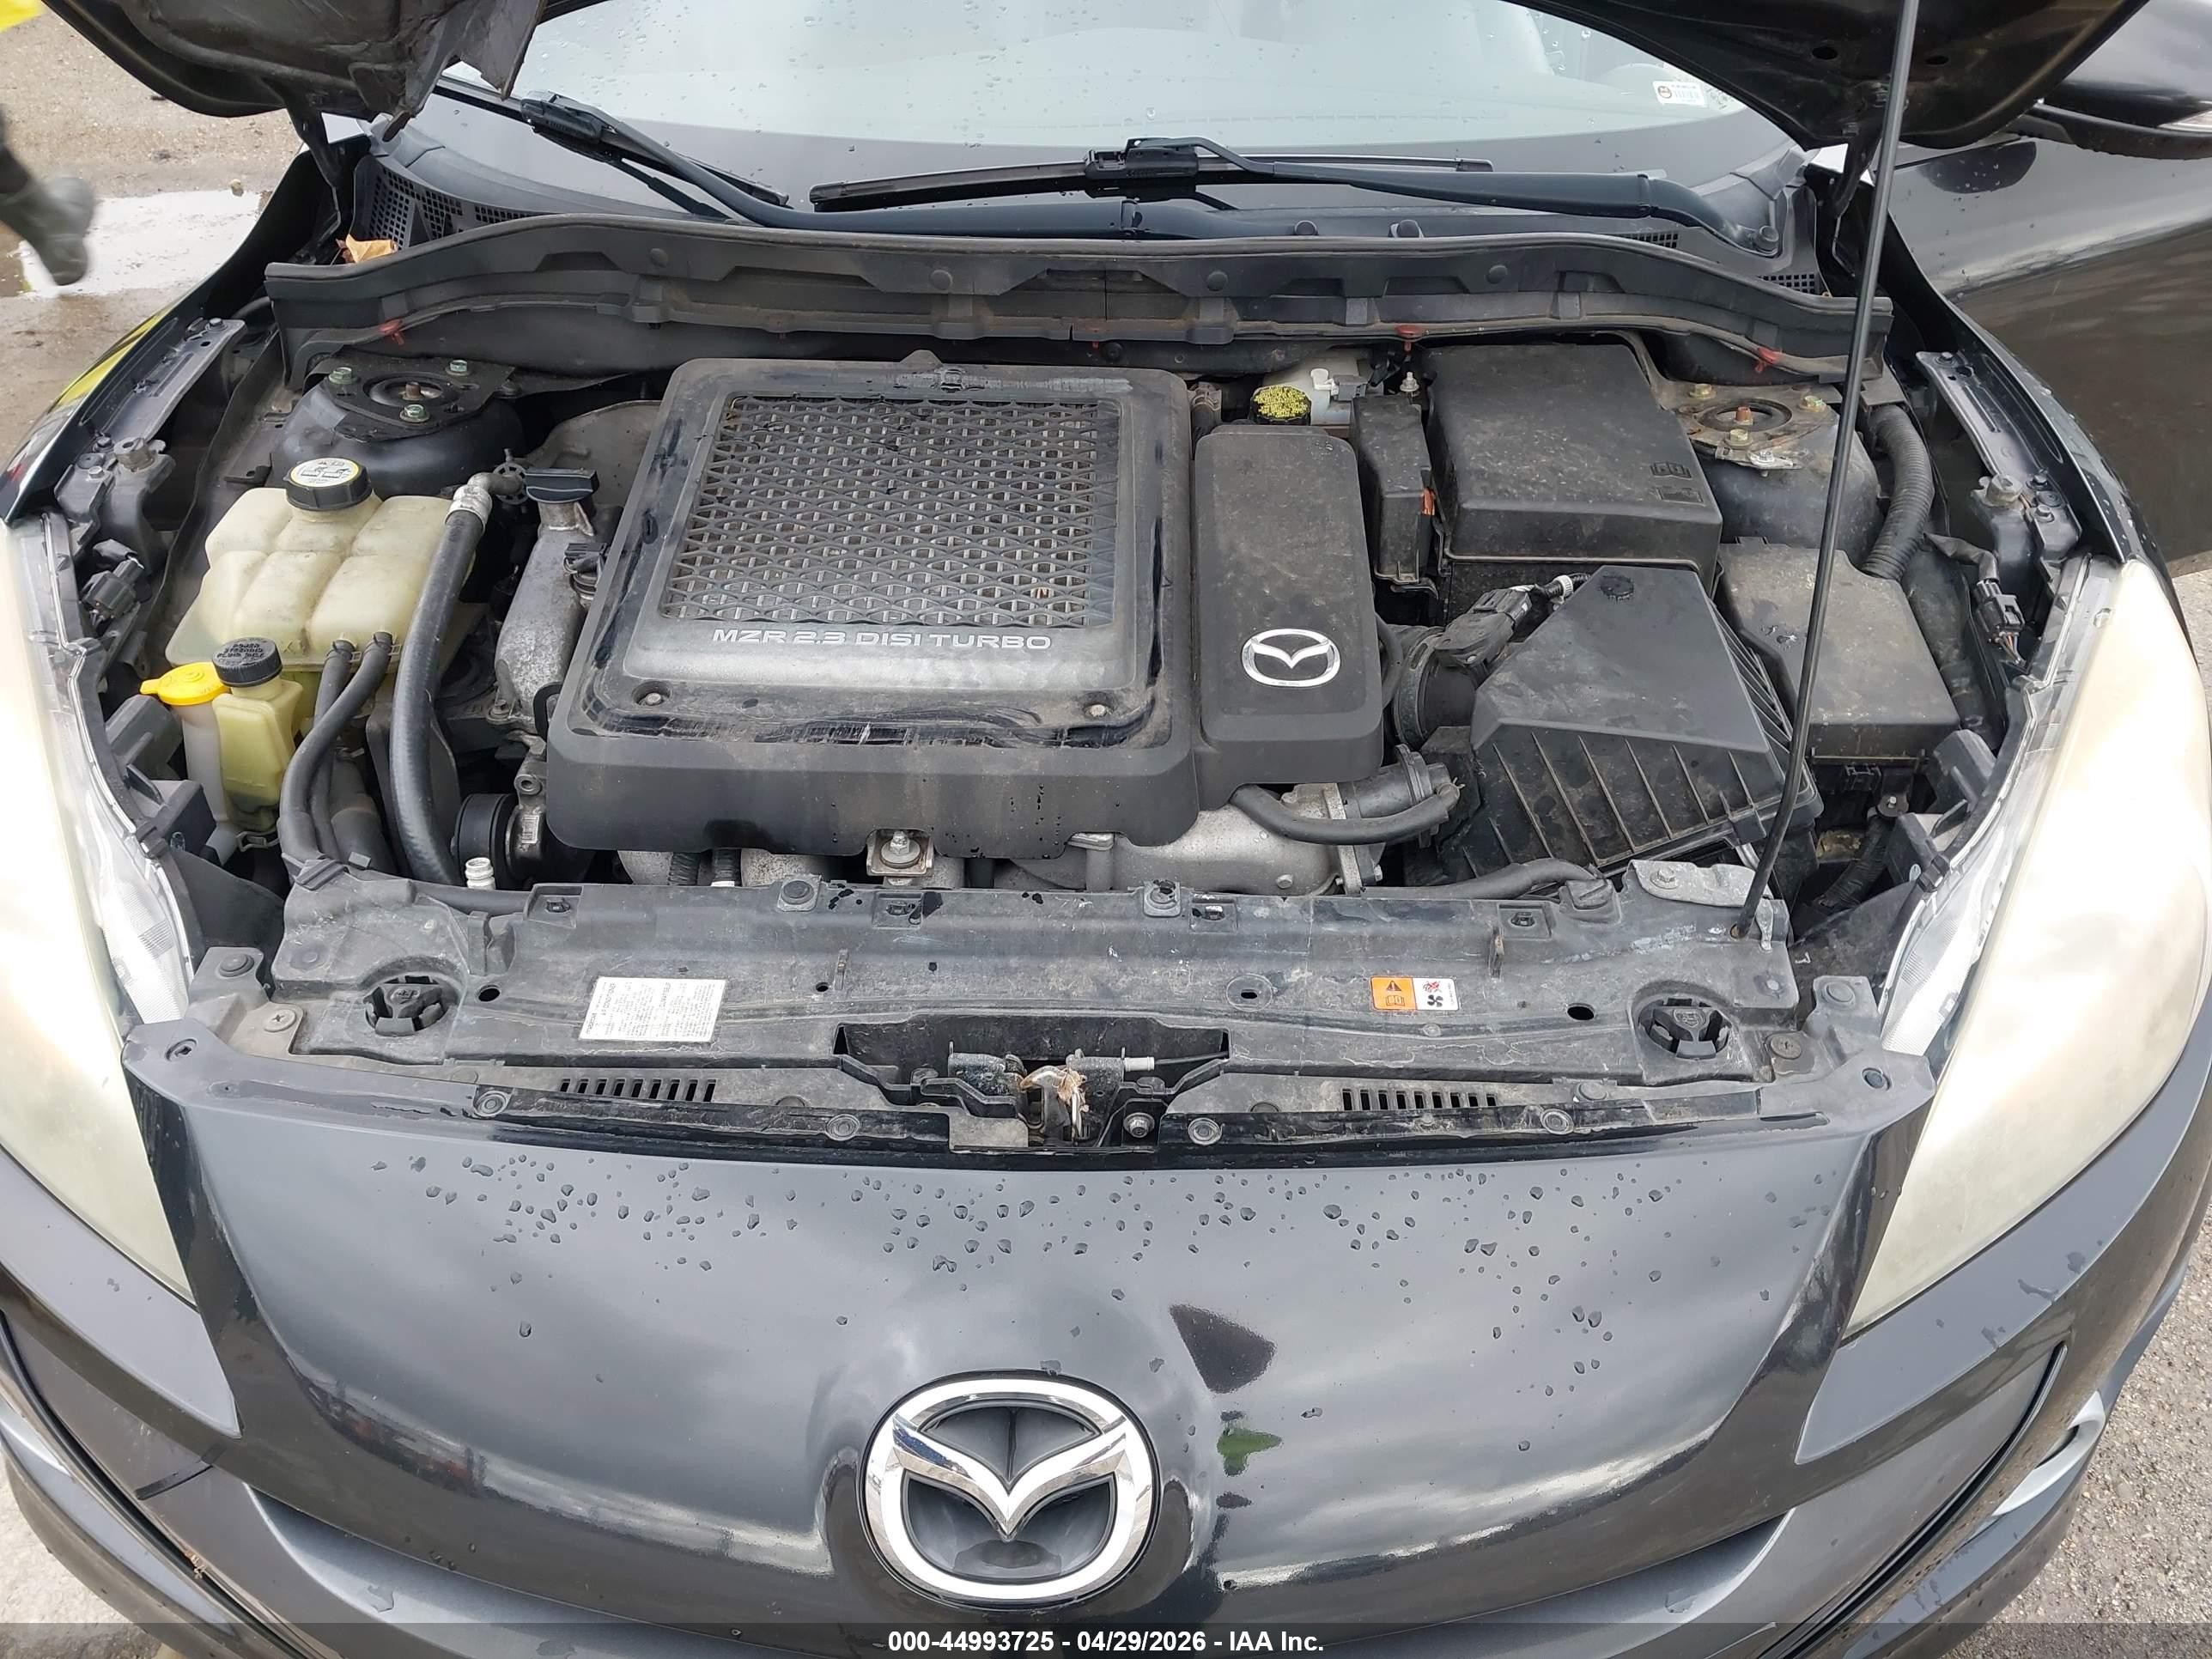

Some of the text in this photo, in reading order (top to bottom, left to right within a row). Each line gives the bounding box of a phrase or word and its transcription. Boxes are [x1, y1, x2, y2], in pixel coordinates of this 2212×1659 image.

[713, 629, 1052, 649] MZR 2.3 DISI TURBO
